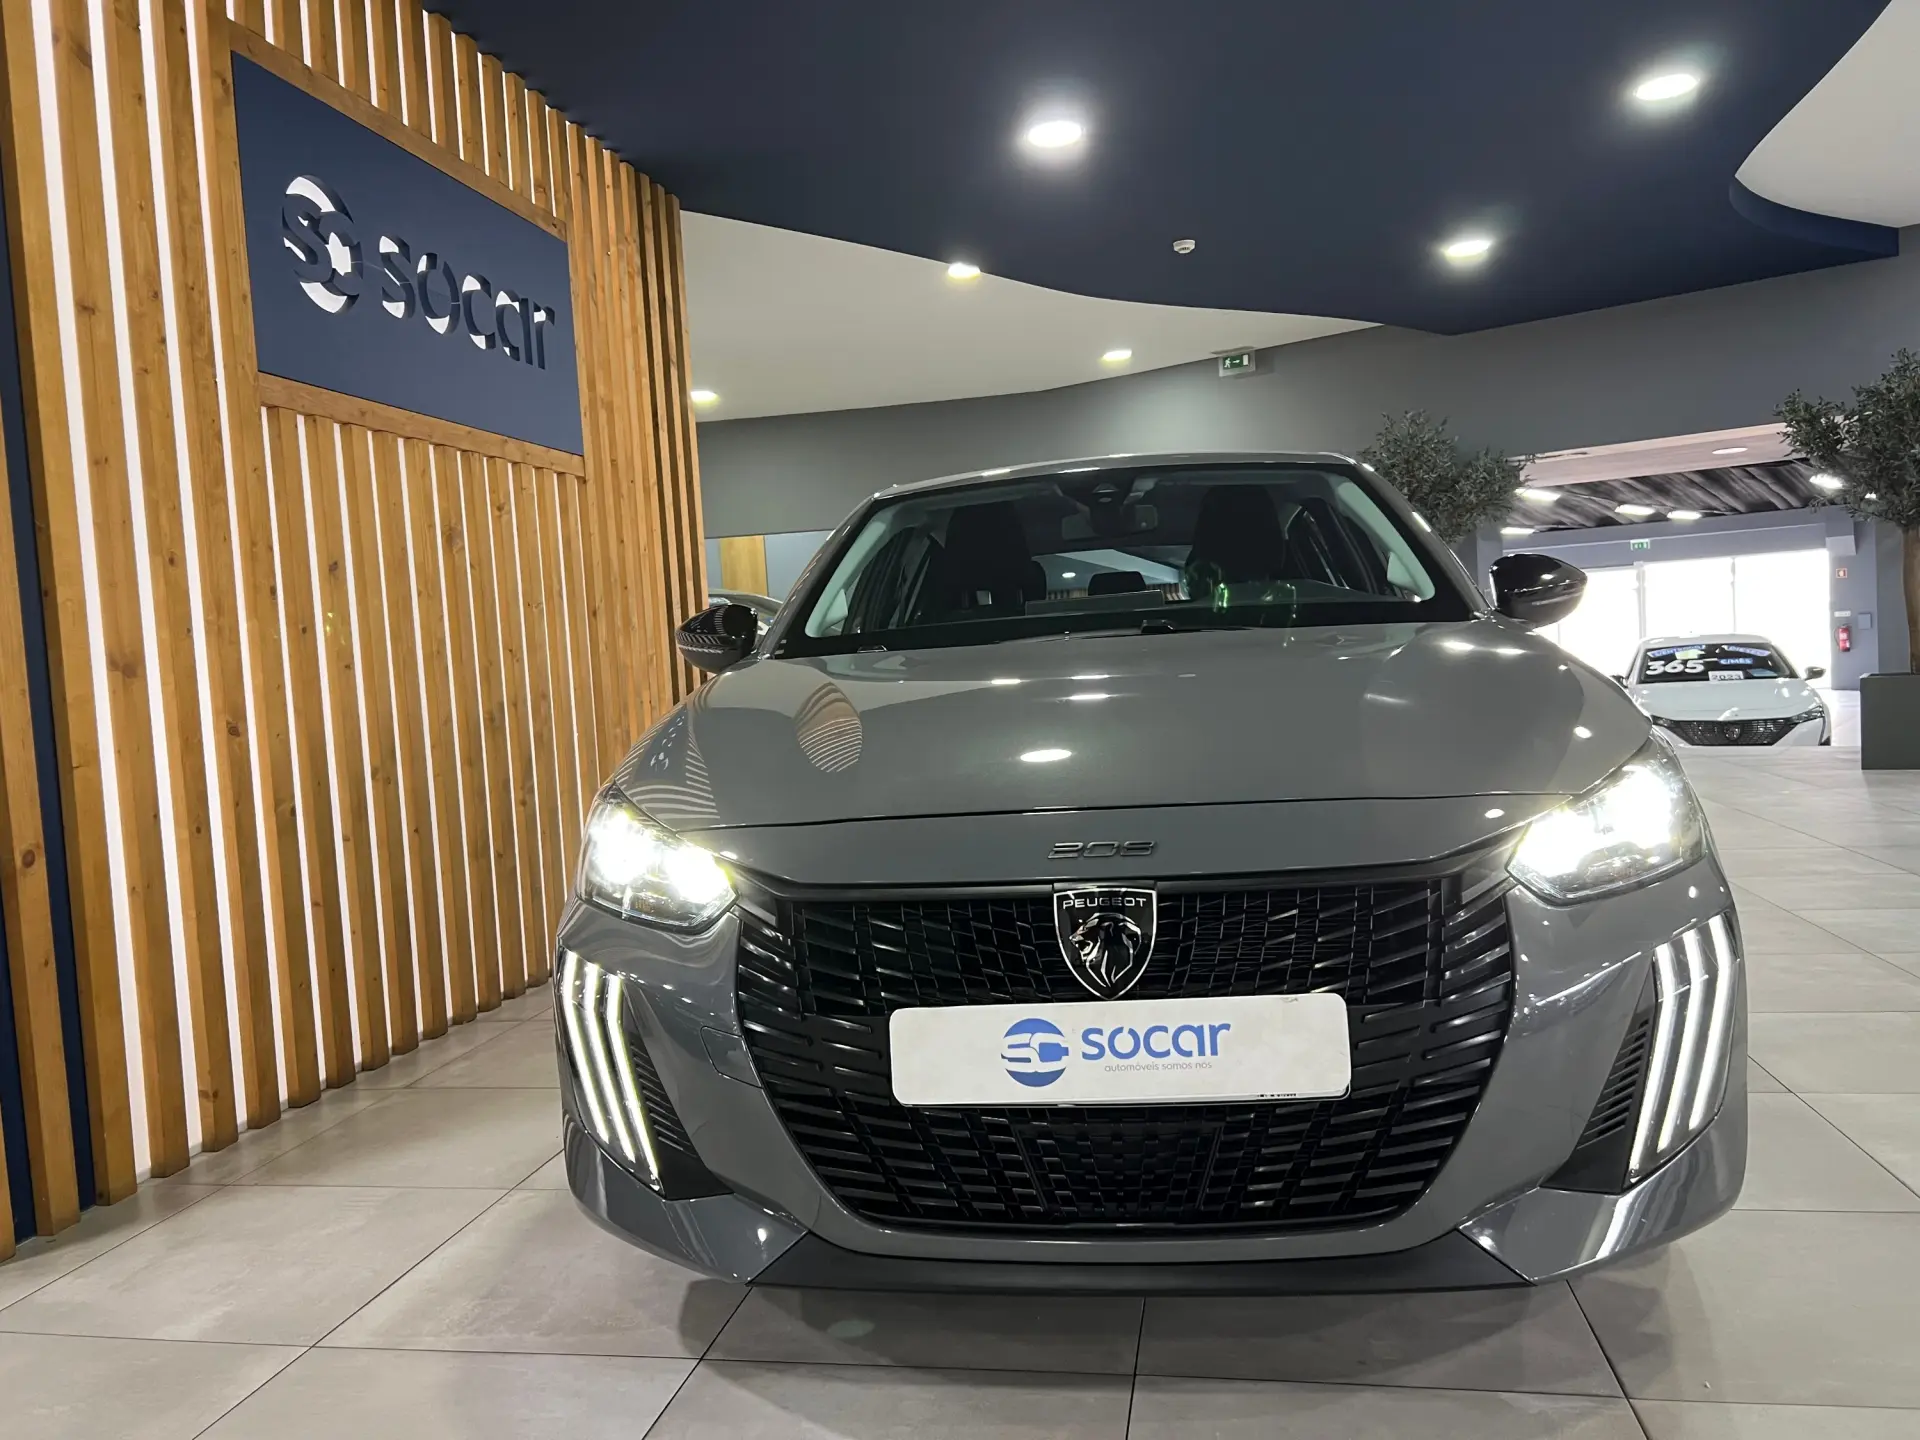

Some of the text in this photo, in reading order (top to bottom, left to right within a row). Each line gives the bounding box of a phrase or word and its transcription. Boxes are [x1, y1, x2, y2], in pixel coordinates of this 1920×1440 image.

[379, 235, 556, 371] socar
[1646, 660, 1705, 675] 365
[1047, 840, 1156, 859] 208
[1062, 897, 1147, 910] PEUGEOT
[1081, 1023, 1232, 1061] socar
[1104, 1061, 1160, 1073] automóveis
[1162, 1061, 1193, 1071] somos
